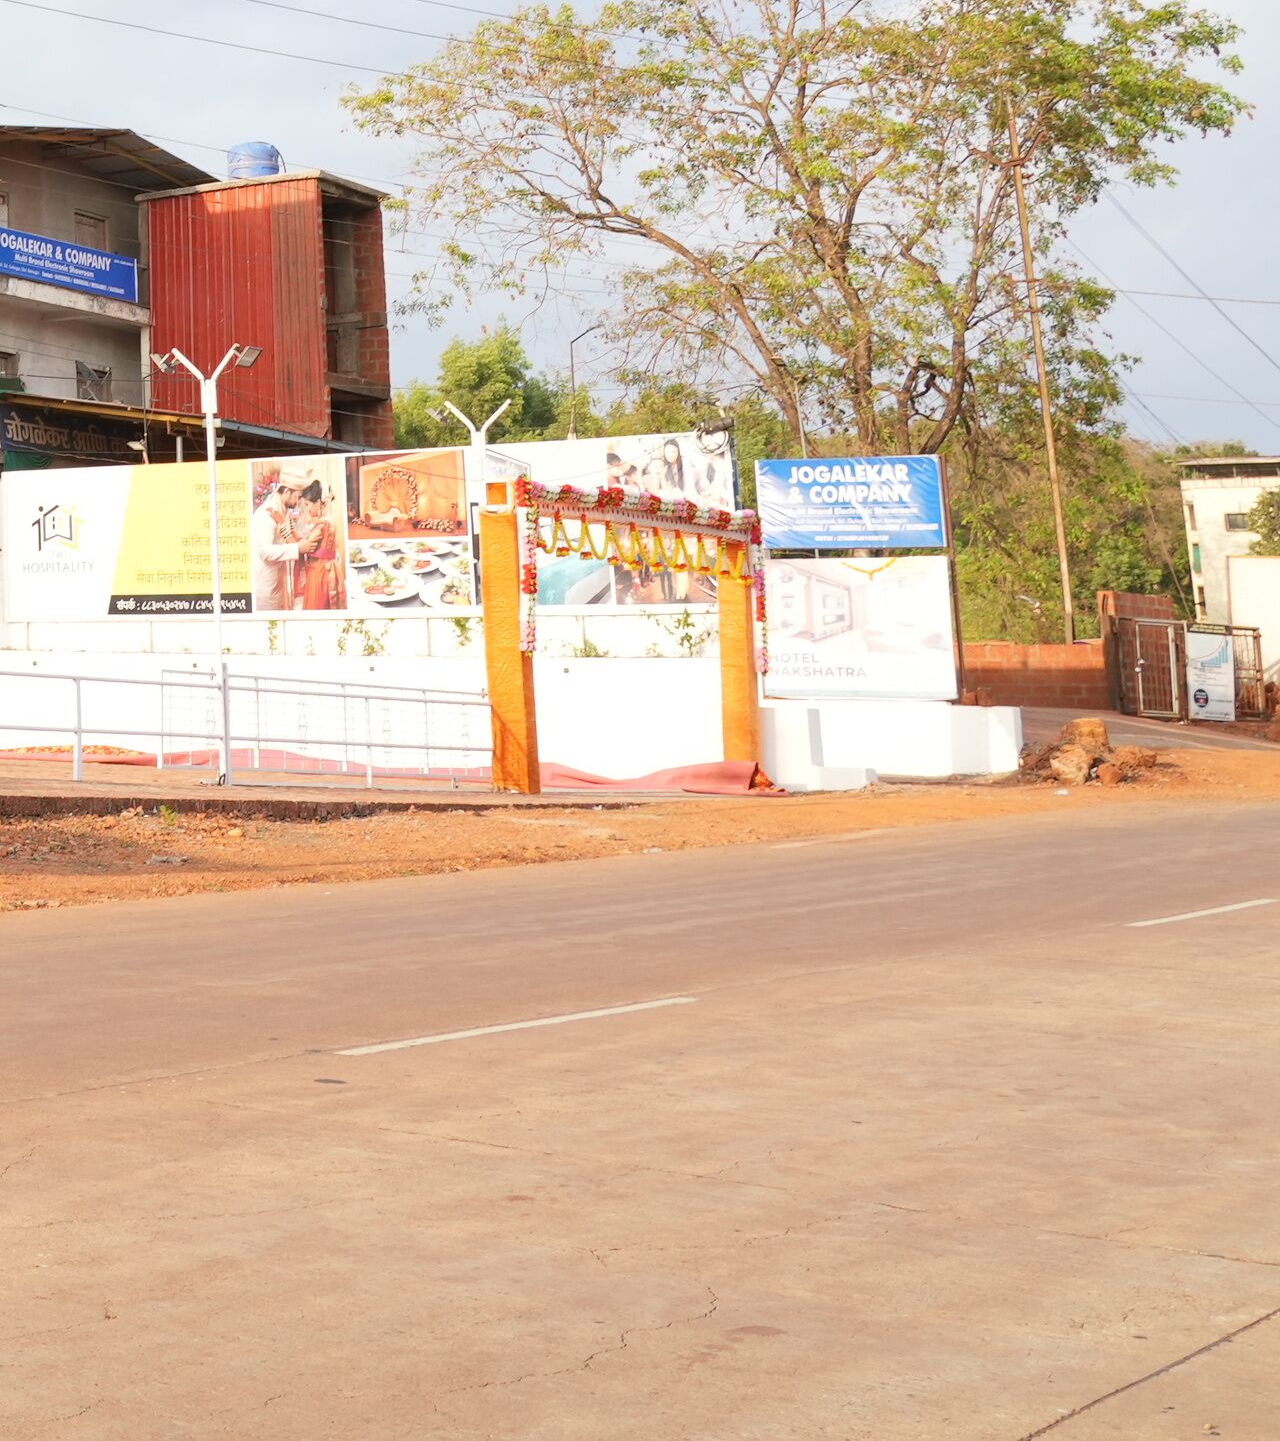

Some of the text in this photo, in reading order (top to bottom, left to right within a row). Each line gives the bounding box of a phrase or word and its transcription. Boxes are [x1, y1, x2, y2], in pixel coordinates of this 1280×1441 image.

[28, 255, 44, 267] Brand
[69, 264, 95, 278] Showroom
[54, 247, 63, 261] &
[65, 248, 112, 272] COMPANY
[788, 464, 910, 484] JOGALEKAR
[788, 484, 912, 504] & COMPANY
[22, 561, 95, 574] HOSPITALITY
